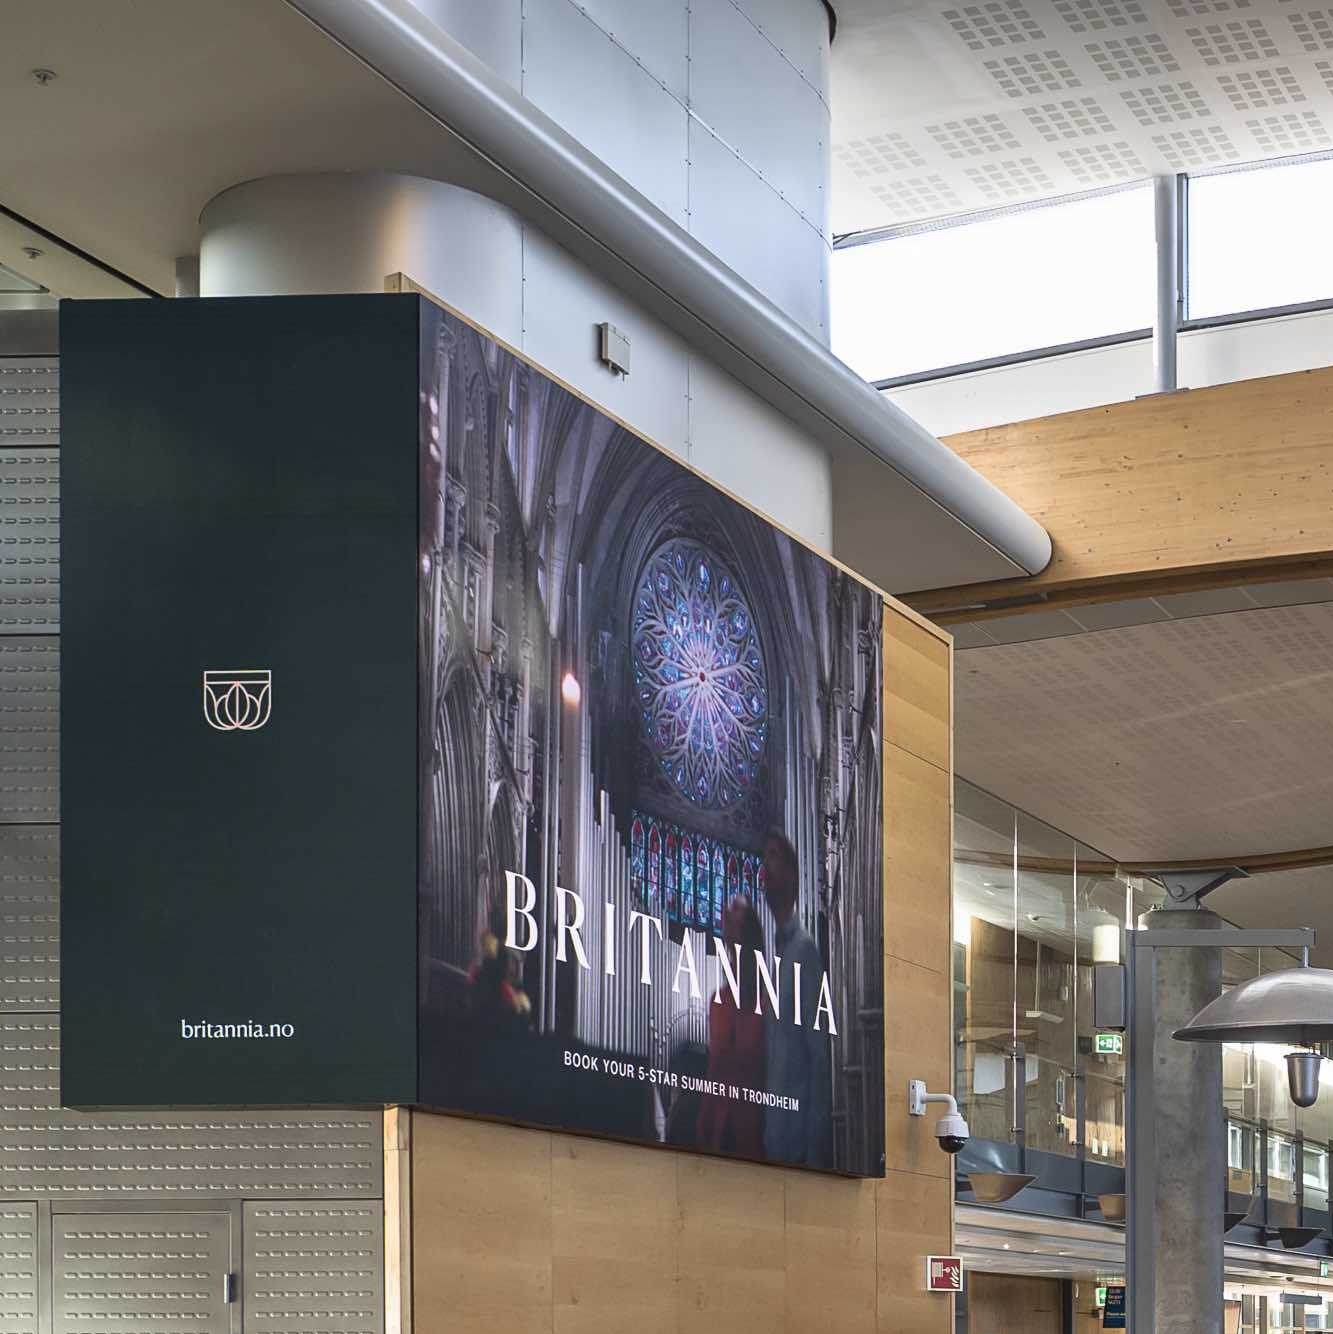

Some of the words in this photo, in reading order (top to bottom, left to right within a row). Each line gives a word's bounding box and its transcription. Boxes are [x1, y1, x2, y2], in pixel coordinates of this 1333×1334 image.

[504, 869, 838, 1036] BRITANNIA
[181, 1019, 295, 1039] britannia.no
[563, 1050, 599, 1072] BOOK
[603, 1058, 635, 1079] YOUR
[638, 1066, 678, 1088] 5-STAR
[681, 1075, 726, 1097] SUMMER
[729, 1085, 739, 1100] IN
[742, 1087, 800, 1112] TRONDHEIM
